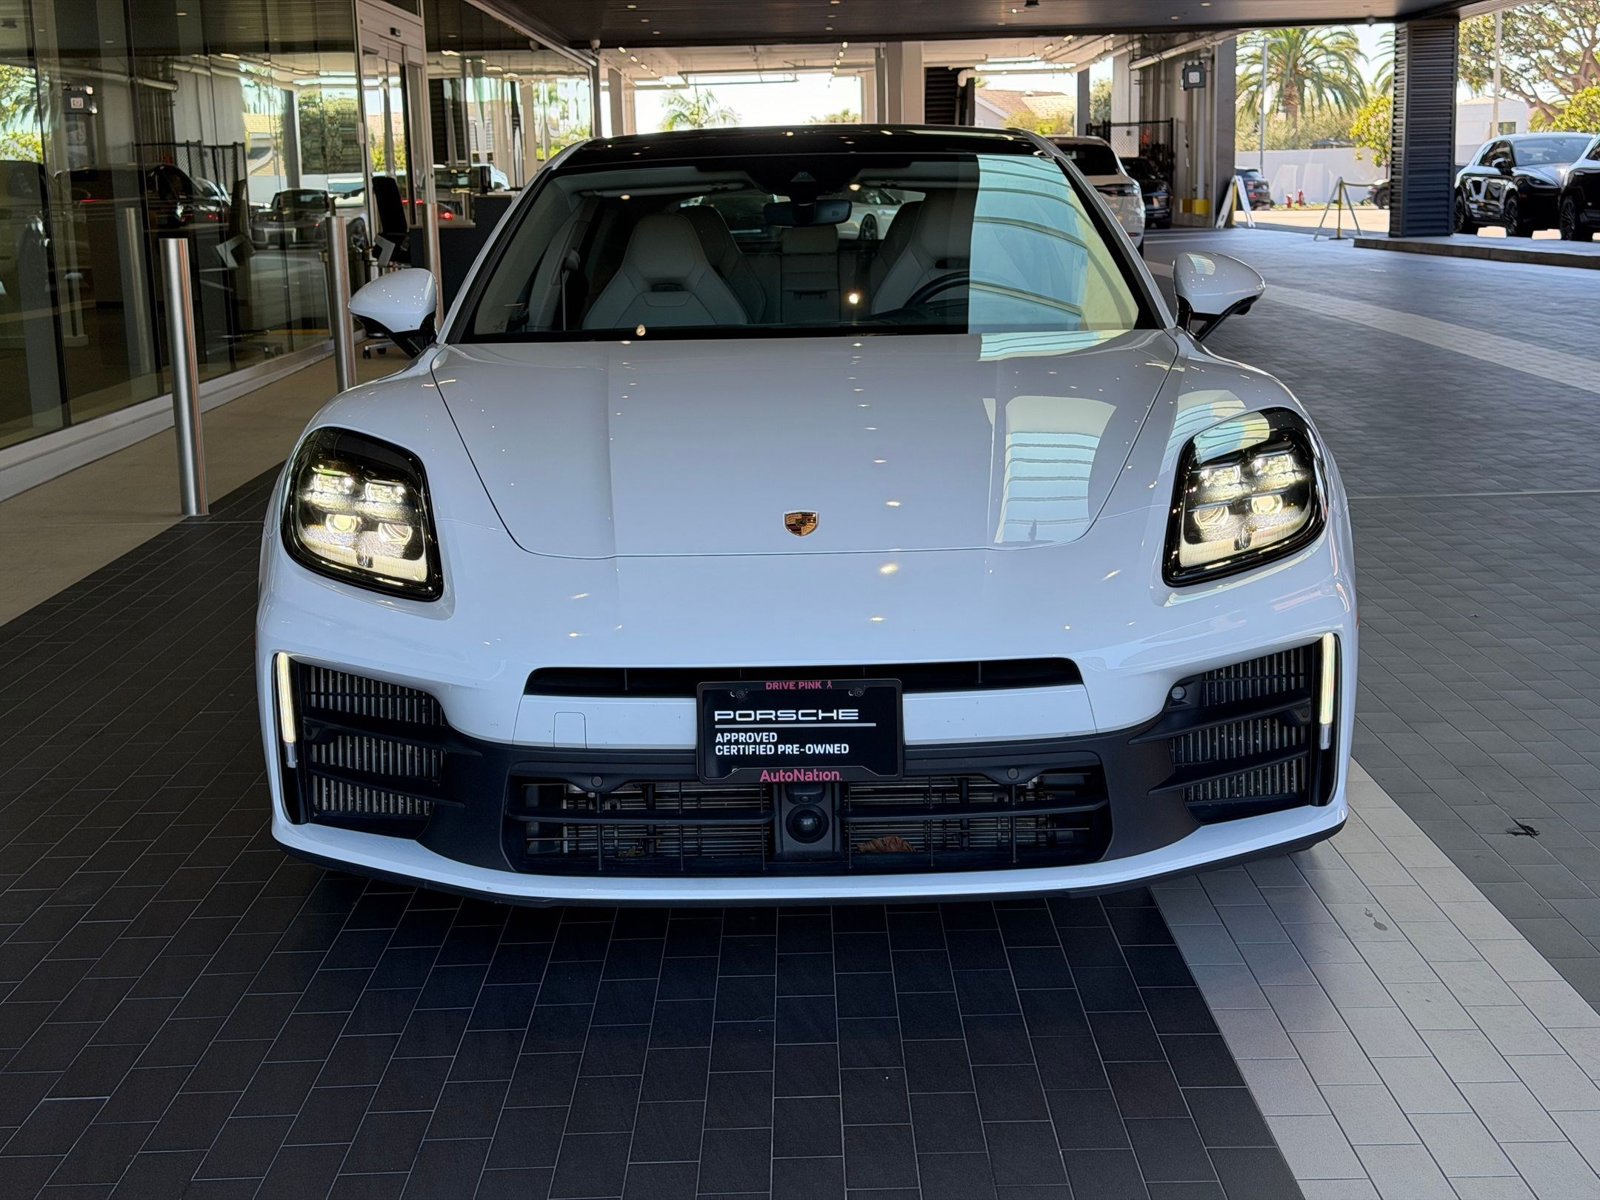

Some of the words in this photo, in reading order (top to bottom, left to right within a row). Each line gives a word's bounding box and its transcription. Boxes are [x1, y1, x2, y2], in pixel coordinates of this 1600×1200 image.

[765, 681, 796, 690] DRIVE
[798, 681, 822, 689] PINK
[714, 709, 859, 721] PORSCHE
[715, 732, 778, 743] APPROVED
[715, 745, 775, 755] CERTIFIED
[777, 744, 850, 754] PRE-OWNED
[759, 769, 841, 782] AutoNation
